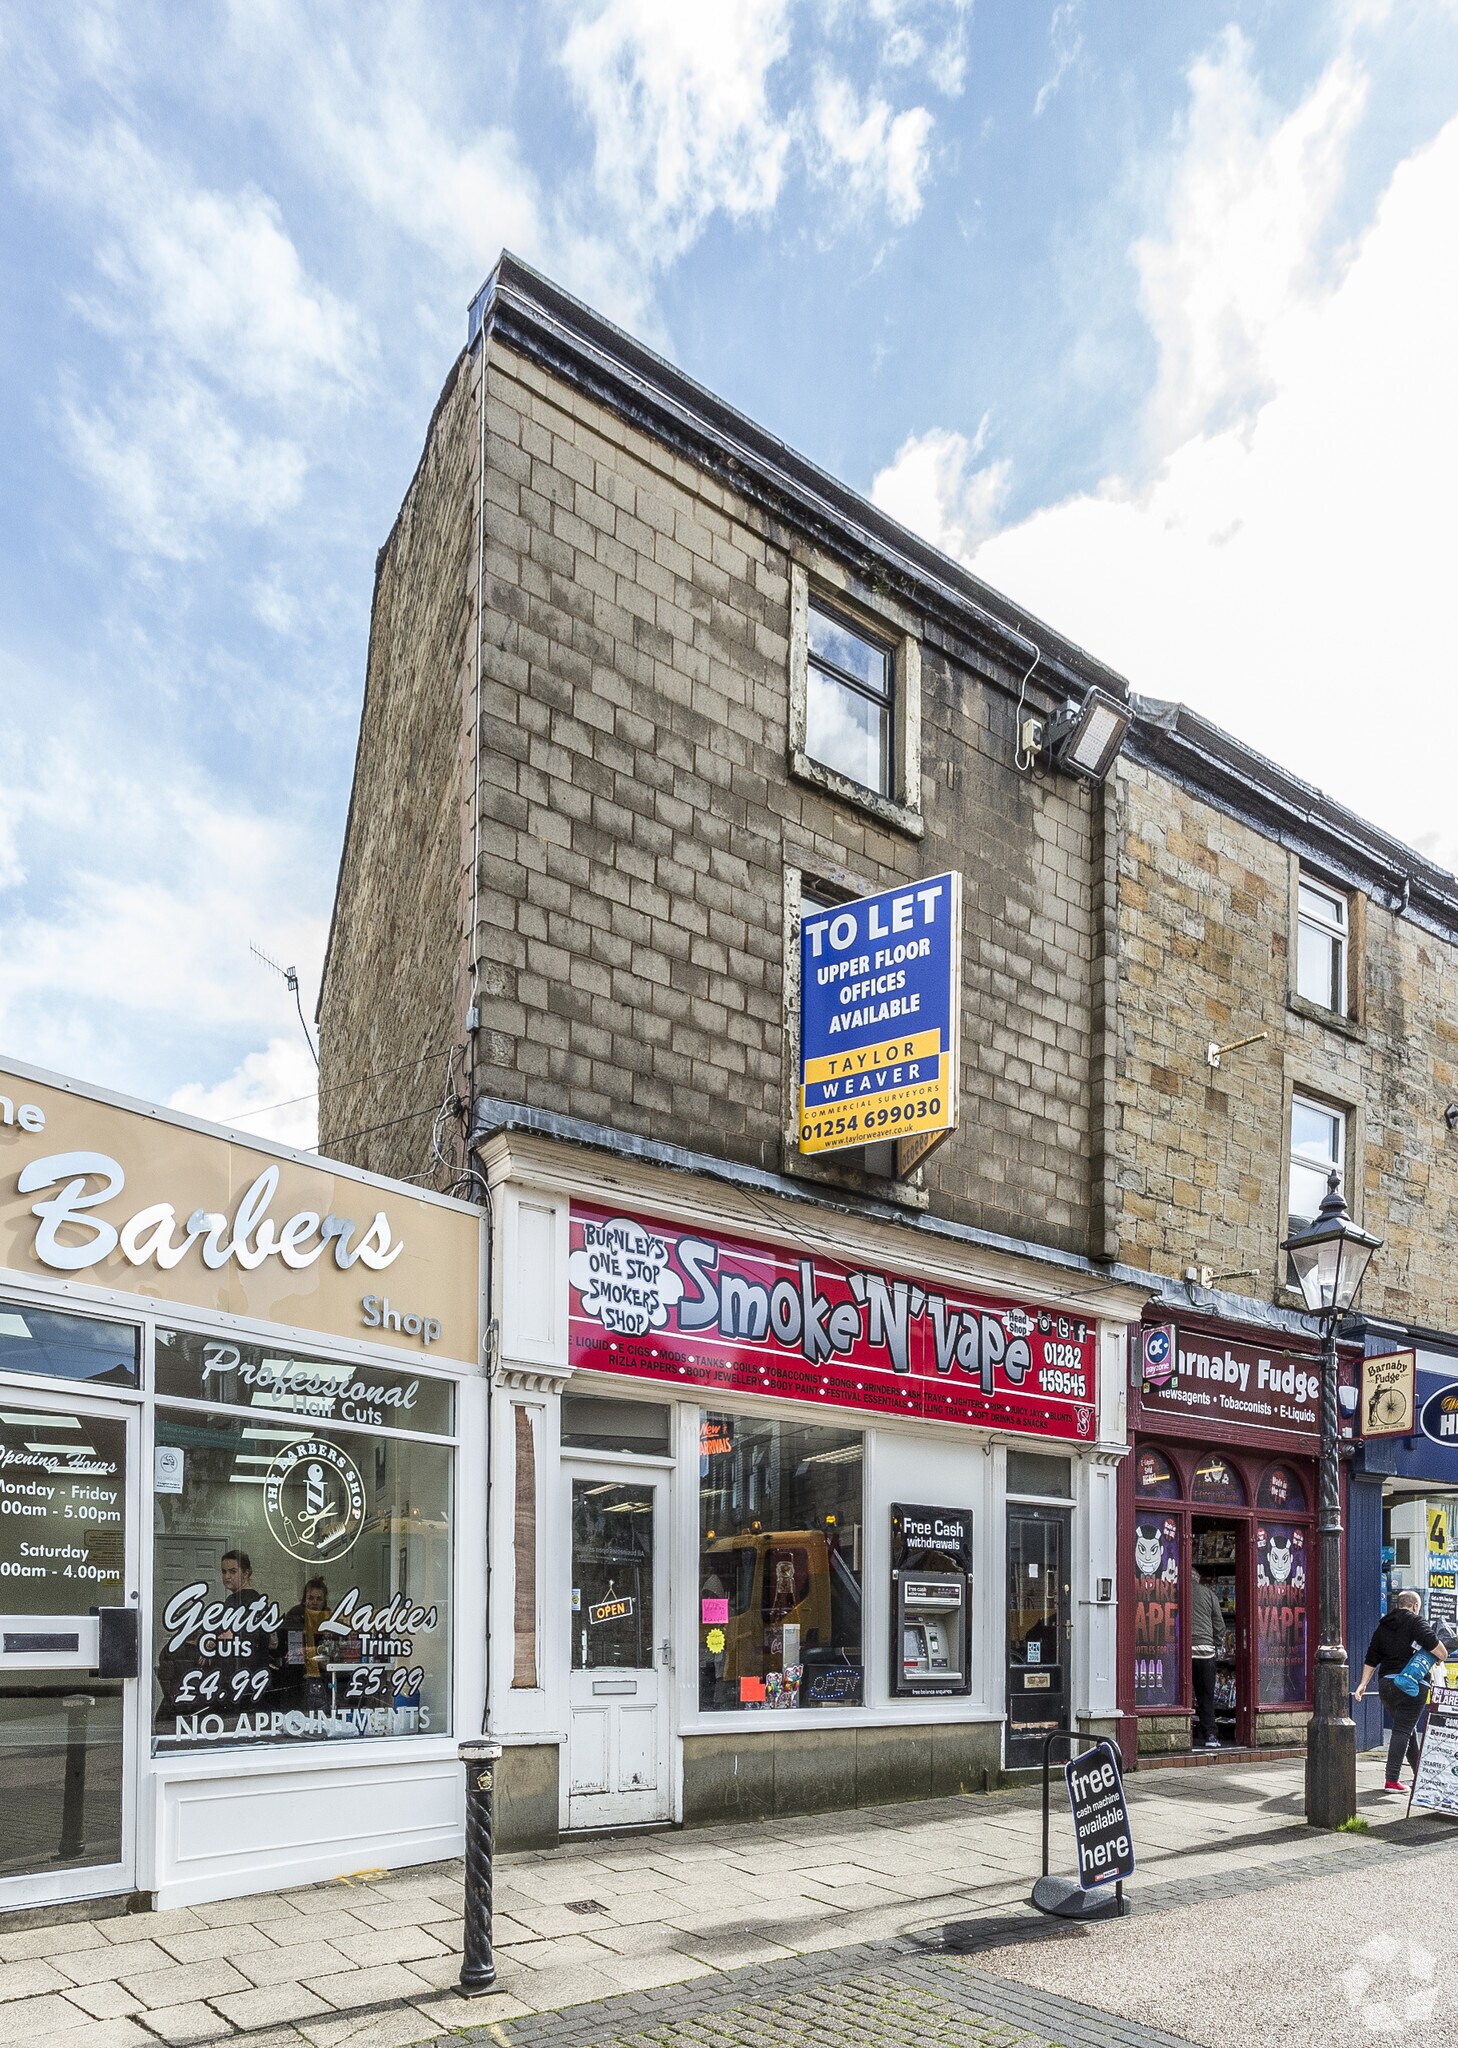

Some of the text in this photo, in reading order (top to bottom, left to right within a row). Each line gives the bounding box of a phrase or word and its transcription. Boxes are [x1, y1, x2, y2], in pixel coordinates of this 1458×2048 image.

[806, 885, 943, 958] TO LET
[817, 938, 931, 986] UPPER FLOOR
[840, 970, 906, 1005] OFFICES
[829, 993, 920, 1034] AVAILABLE
[829, 1042, 914, 1074] TAYLOR
[822, 1063, 920, 1099] WEAVER
[805, 1085, 940, 1119] COMMERCIAL SURVEYORS
[802, 1098, 941, 1141] 01254 699030
[825, 1124, 913, 1147] www.taylorweaver.co.uk
[17, 1151, 404, 1270] Barbers
[585, 1223, 665, 1259] BURNLEY'S
[589, 1253, 660, 1284] ONE STOP
[589, 1279, 660, 1315] SMOKERS
[676, 1236, 862, 1364] Smoke
[361, 1294, 442, 1345] Shop
[605, 1307, 644, 1333] SHOP
[1008, 1311, 1027, 1324] Head
[1008, 1322, 1027, 1336] Shop
[1043, 1341, 1082, 1370] 01282
[1145, 1362, 1170, 1376] payzone
[1367, 1360, 1408, 1378] Barnaby
[202, 1341, 420, 1410] Professional
[576, 1337, 609, 1351] LIQUID
[627, 1345, 651, 1357] CIGS
[659, 1350, 687, 1363] MODS
[695, 1355, 724, 1369] TANKS
[733, 1360, 758, 1374] COILS
[766, 1367, 822, 1385] TOBACCONIST
[829, 1376, 857, 1390] BONGS
[863, 1383, 901, 1397] GRINDERS
[907, 1389, 922, 1400] ASH
[923, 1391, 946, 1404] TRAYS
[951, 1396, 984, 1409] LIGHTERS
[1010, 1405, 1028, 1417] JUICY
[1029, 1407, 1045, 1419] JAYS
[1049, 1411, 1073, 1423] BLUNTS
[1038, 1367, 1086, 1398] 459545
[1258, 1359, 1320, 1403] Fudge
[1374, 1372, 1400, 1384] Fudge
[608, 1355, 637, 1369] RIZLA
[640, 1360, 677, 1375] PAPERS
[686, 1367, 711, 1380] BODY
[713, 1370, 763, 1387] JEWELLERY
[770, 1379, 793, 1391] BODY
[795, 1383, 819, 1395] PAINT
[826, 1388, 861, 1402] FESTIVAL
[864, 1393, 907, 1409] ESSENTIALS
[912, 1401, 942, 1414] ROLLING
[945, 1405, 968, 1417] TRAYS
[973, 1410, 989, 1421] SOFT
[990, 1412, 1015, 1425] DRINKS
[1023, 1417, 1048, 1429] SNACKS
[1159, 1388, 1316, 1423] Newsagents Tobacconists E-Liquids
[292, 1394, 383, 1425] Hair Cuts
[66, 1452, 117, 1473] Hours
[700, 1437, 732, 1456] ARRIVALS
[71, 1485, 118, 1505] Friday
[268, 1442, 363, 1519] THE BARBERS SHOP
[64, 1505, 121, 1523] 5.00pm
[903, 1517, 963, 1537] Free Cash
[907, 1536, 960, 1550] withdrawals
[1430, 1514, 1445, 1550] 4
[20, 1542, 89, 1562] Saturday
[1429, 1556, 1458, 1572] MEANS
[63, 1565, 120, 1582] 4.00pm
[1430, 1575, 1455, 1589] MORE
[164, 1583, 284, 1653] Gents
[317, 1588, 439, 1636] Ladies
[596, 1602, 625, 1619] OPEN
[1258, 1606, 1306, 1644] VAPE
[199, 1633, 252, 1657] Cuts
[358, 1633, 413, 1656] Trims
[175, 1668, 270, 1704] £4.99
[346, 1666, 424, 1698] £5.99
[813, 1676, 858, 1692] OPEN
[175, 1705, 431, 1742] NO APPOINTMENTS
[1071, 1763, 1115, 1802] free
[1076, 1792, 1120, 1819] cash machine
[1079, 1807, 1124, 1838] available
[1081, 1835, 1129, 1872] here
